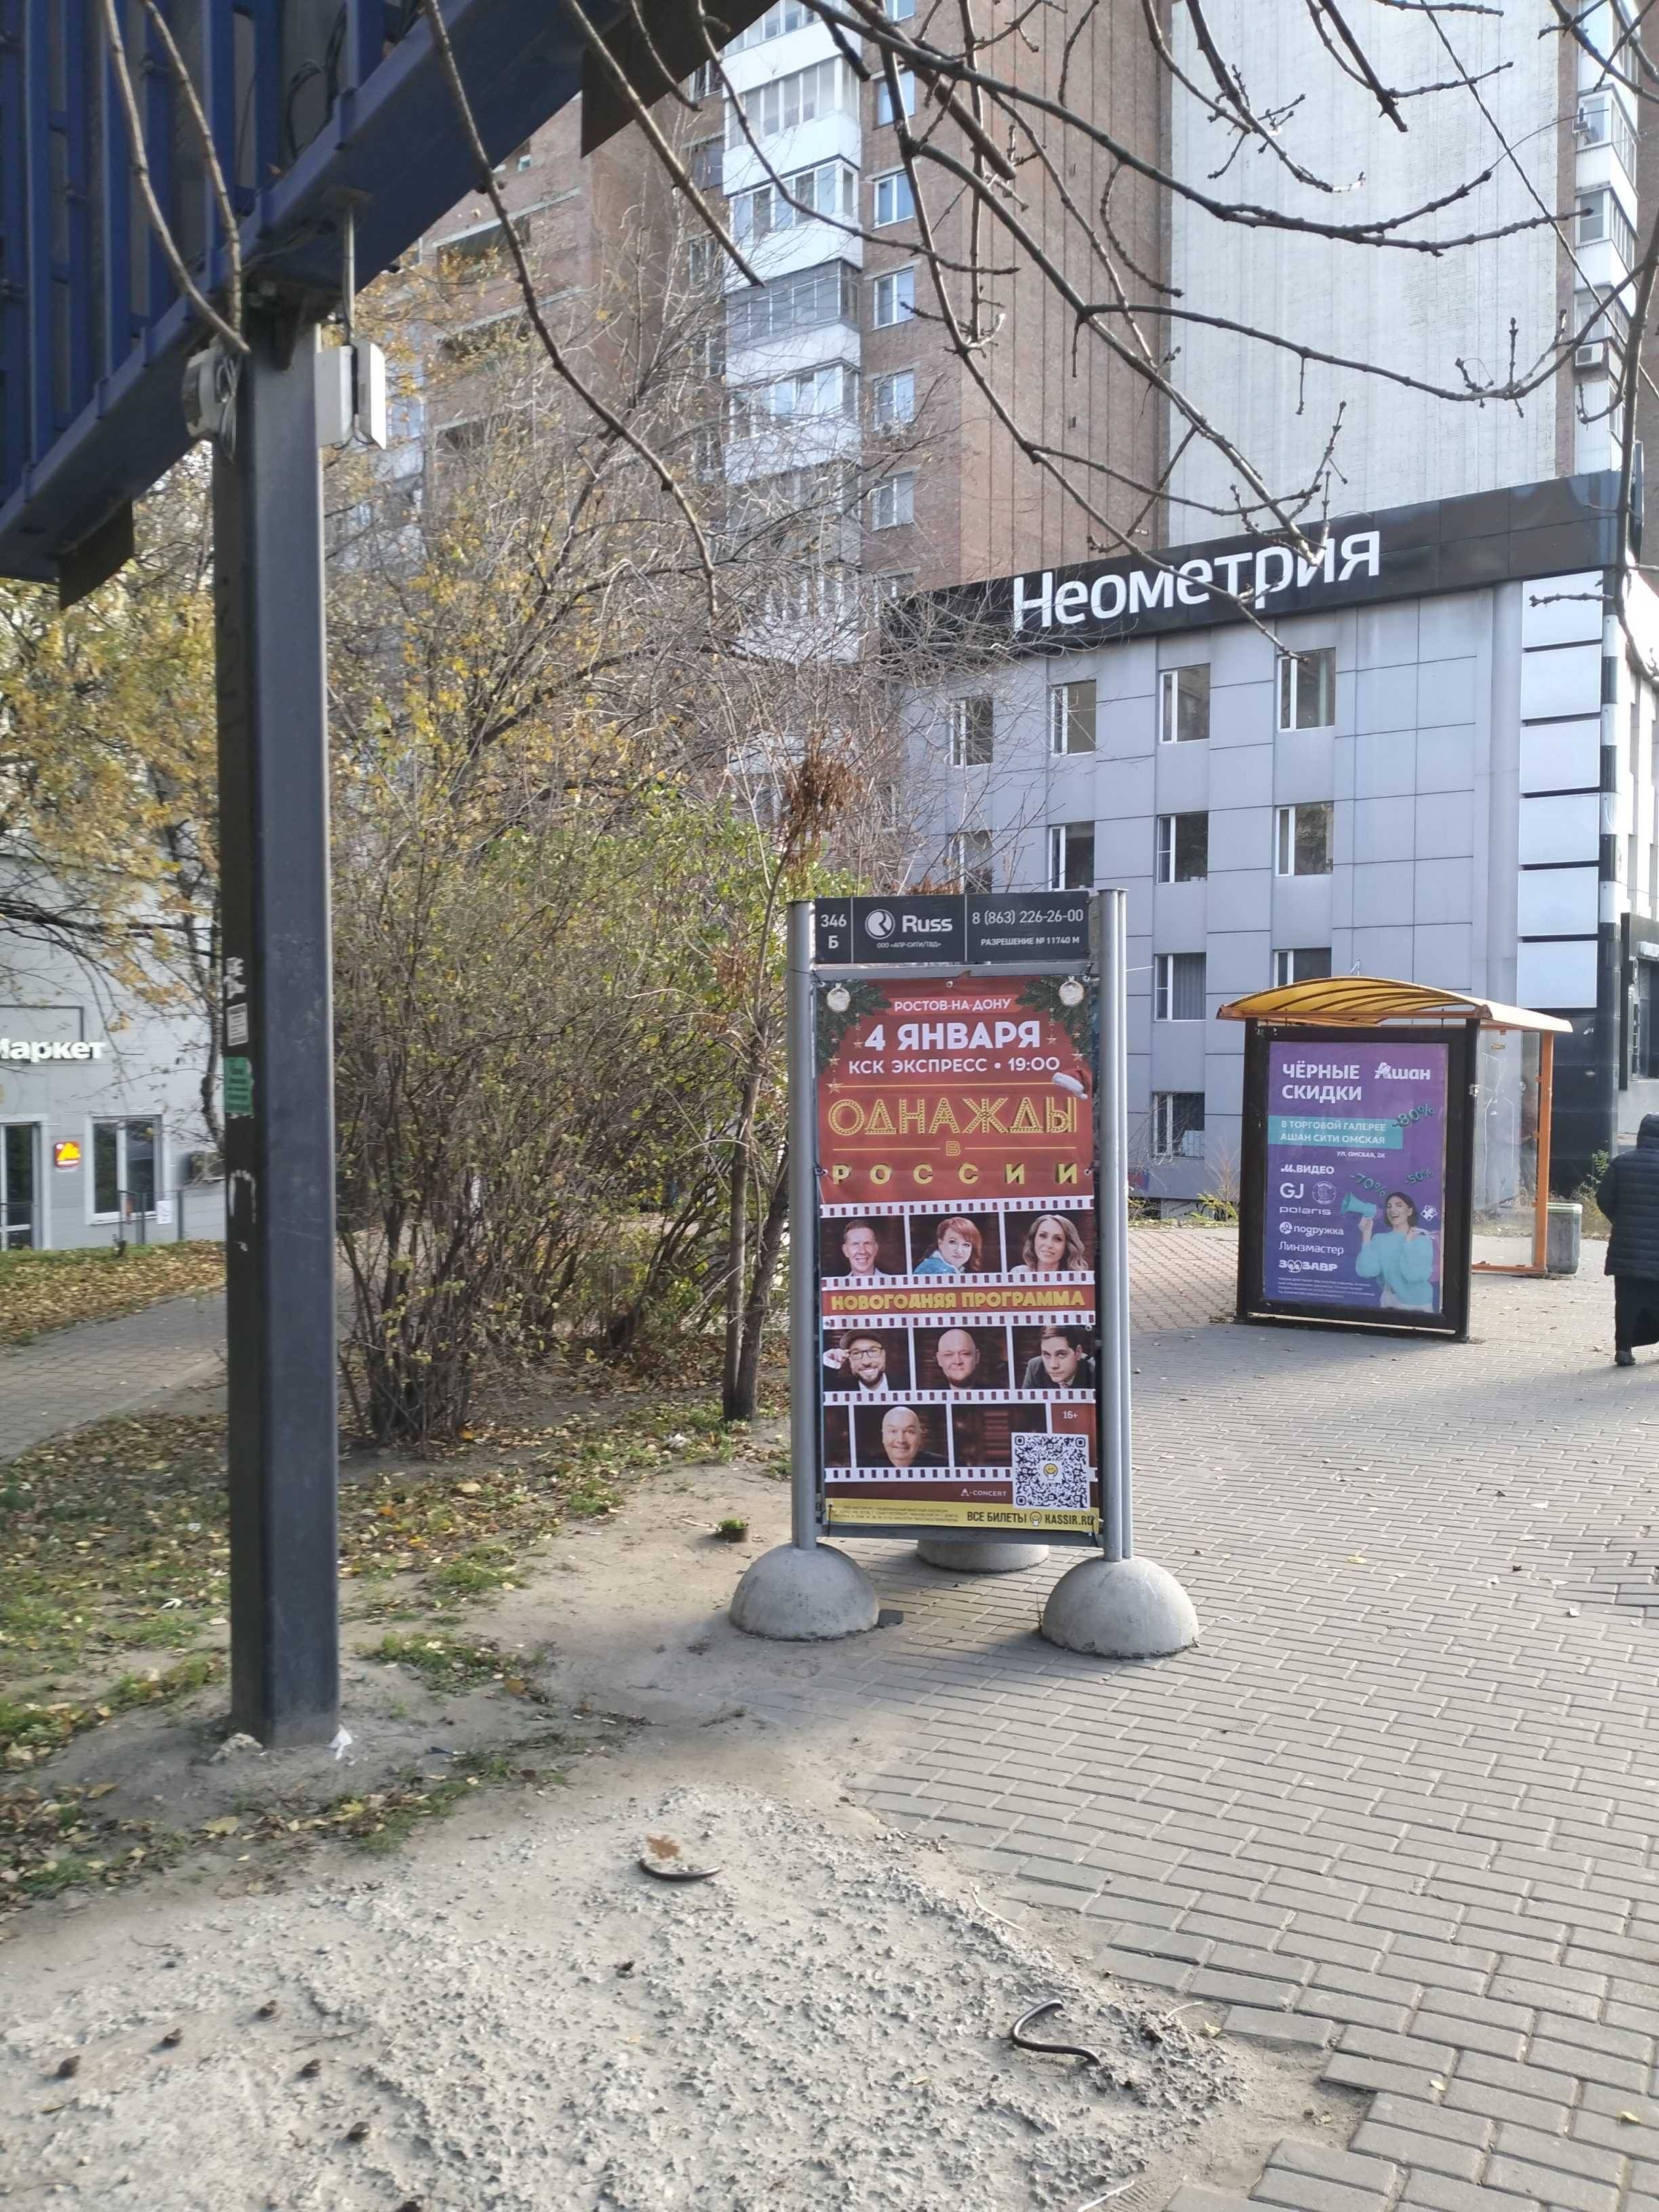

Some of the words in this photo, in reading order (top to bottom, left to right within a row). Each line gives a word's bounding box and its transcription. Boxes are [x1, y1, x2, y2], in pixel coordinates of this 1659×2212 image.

[1014, 531, 1380, 632] Неометрия
[821, 914, 846, 927] 346
[902, 915, 953, 933] Russ
[972, 912, 980, 924] 8
[985, 910, 1015, 925] (863)
[1019, 909, 1084, 922] 226-26-00
[828, 935, 839, 949] Б
[981, 938, 1034, 946] РАЗРЕШЕНИЕ
[1046, 937, 1070, 945] 11740
[894, 998, 1011, 1012] РОСТОВ-НА-ДОНУ
[865, 1024, 885, 1051] 4
[897, 1021, 1040, 1050] ЯНВАРЯ
[848, 1060, 884, 1074] КСК
[891, 1058, 987, 1073] ЭКСПРЕСС
[1008, 1057, 1061, 1071] 19:00
[1282, 1061, 1359, 1079] ЧЁРНЫЕ
[1374, 1062, 1431, 1080] Ашан
[1282, 1084, 1361, 1103] СКИДКИ
[828, 1097, 1078, 1136] ОДНАЖДЫ
[1392, 1103, 1435, 1127] -80%
[1290, 1120, 1341, 1130] ТОРГОВОЙ
[1344, 1122, 1387, 1131] ГАЛЕРЕЕ
[1280, 1133, 1311, 1141] АШАН
[1313, 1134, 1339, 1143] СИТИ
[1342, 1135, 1385, 1144] ОМСКАЯ
[945, 1141, 961, 1156] В
[832, 1163, 1078, 1185] РОССИИ
[1404, 1169, 1434, 1185] -50%
[1279, 1183, 1304, 1199] GJ
[1350, 1173, 1388, 1197] -70%
[1279, 1206, 1332, 1215] polaris
[1293, 1225, 1345, 1237] подружка
[1279, 1242, 1344, 1255] Линзмастер
[831, 1293, 956, 1311] НОВОГОДНЯЯ
[962, 1290, 1085, 1308] ПРОГРАММА
[1063, 1410, 1078, 1419] 16+
[967, 1511, 983, 1521] ВСЕ
[987, 1512, 1027, 1523] БИЛЕТЫ
[1044, 1513, 1094, 1525] KASSIR.RU
